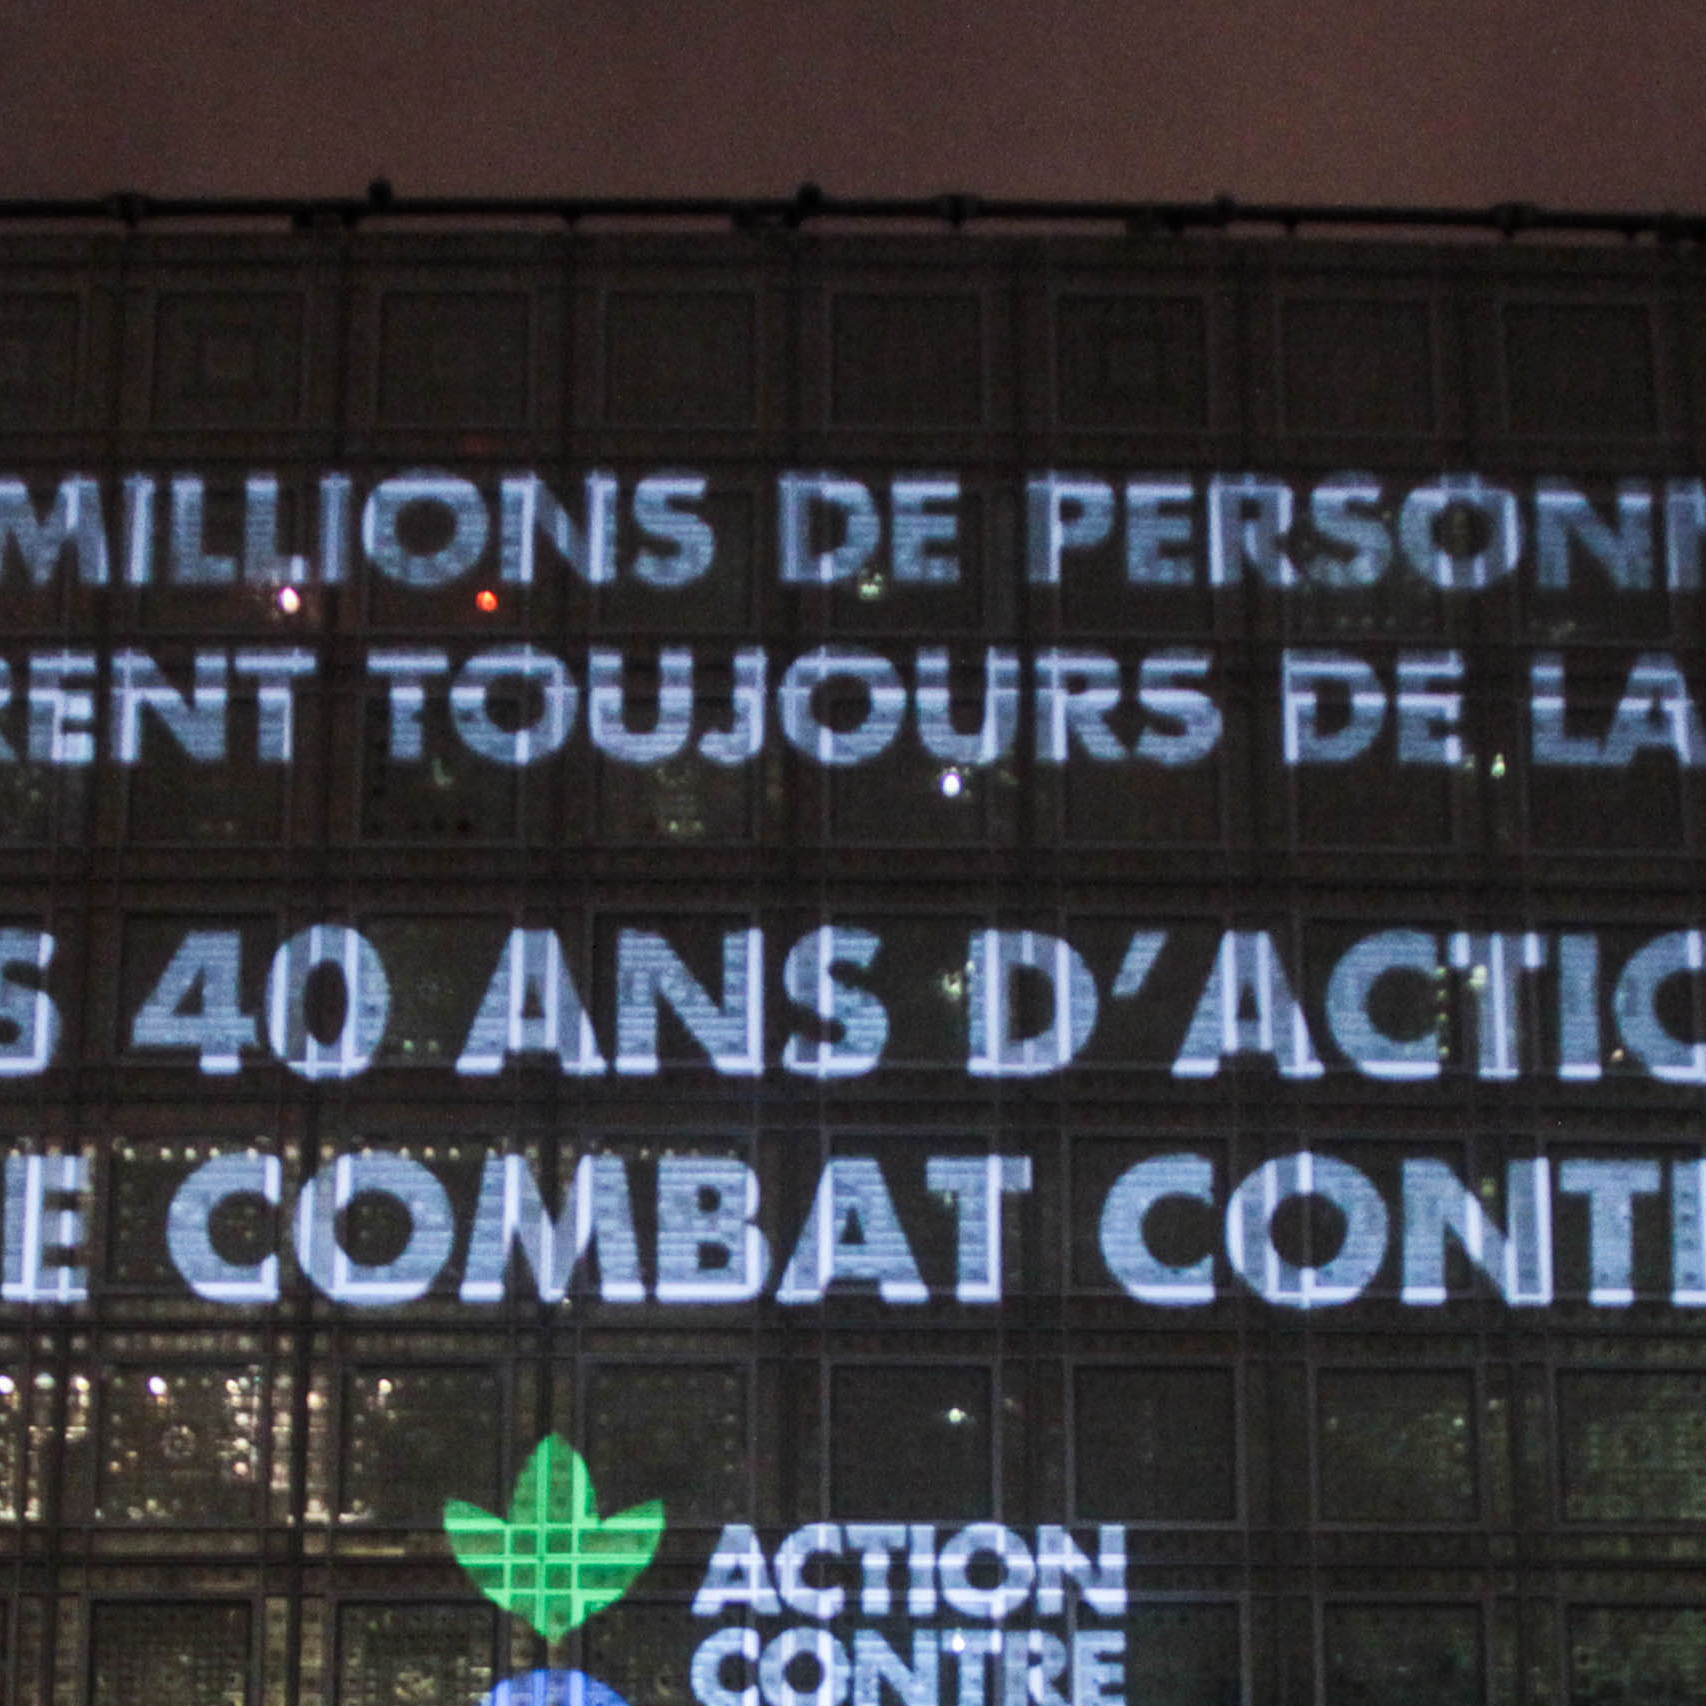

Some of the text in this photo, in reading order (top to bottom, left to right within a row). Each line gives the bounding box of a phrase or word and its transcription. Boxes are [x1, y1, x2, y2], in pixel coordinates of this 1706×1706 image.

[778, 472, 960, 586] DE
[366, 643, 1224, 767] TOUJOURS
[1283, 647, 1464, 767] DE
[132, 925, 390, 1079] 40
[456, 927, 890, 1079] ANS
[166, 1153, 1032, 1304] COMBAT
[691, 1522, 1128, 1618] ACTION
